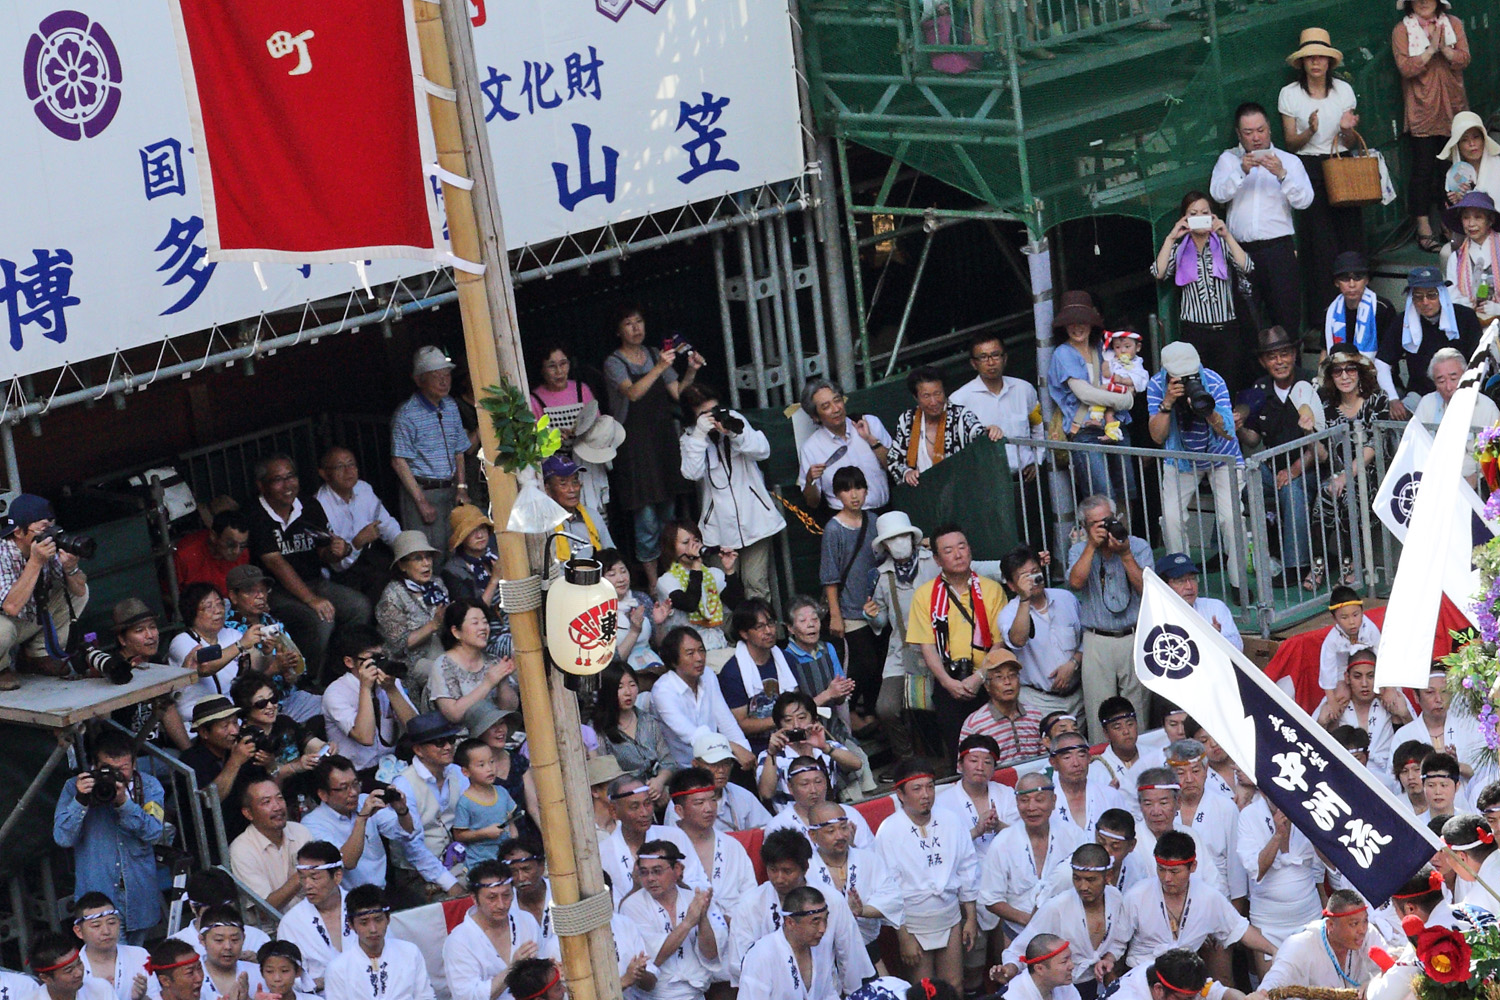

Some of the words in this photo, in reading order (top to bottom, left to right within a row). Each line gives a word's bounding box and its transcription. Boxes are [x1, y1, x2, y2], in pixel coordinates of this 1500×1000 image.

[266, 28, 315, 75] 町
[481, 44, 605, 123] 文化財
[552, 91, 741, 213] 山笠
